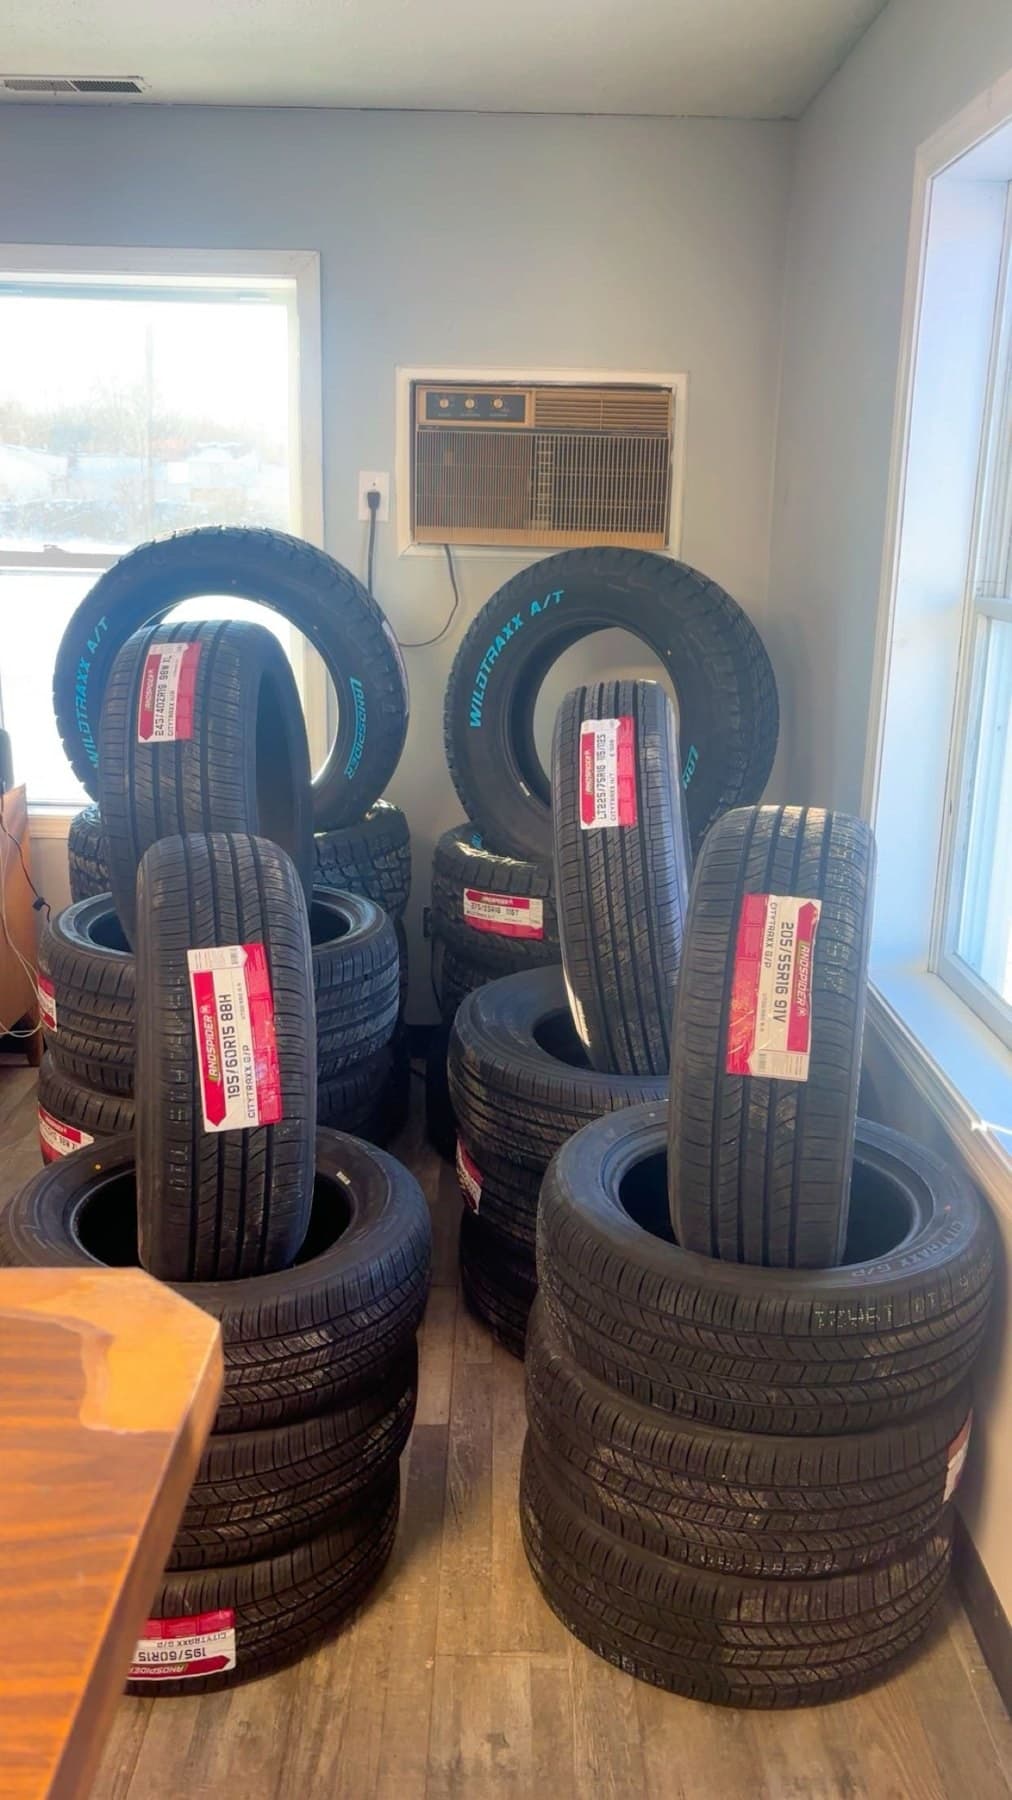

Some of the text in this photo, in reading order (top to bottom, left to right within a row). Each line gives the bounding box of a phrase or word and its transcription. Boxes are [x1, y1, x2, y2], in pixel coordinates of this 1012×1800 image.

[87, 615, 108, 654] A/T
[469, 590, 565, 728] WILDTRAXX A/T
[765, 902, 778, 948] CITYTRAXX
[772, 921, 794, 1024] 205/55R16 91V
[794, 940, 811, 1006] LANDSPIDER
[203, 1014, 220, 1083] LANDSPIDER
[218, 994, 240, 1099] 195/60R15 88H
[244, 1065, 256, 1119] CITYTRAXX
[138, 1647, 206, 1663] 195/60R15
[176, 1631, 227, 1648] CITYTRAXX
